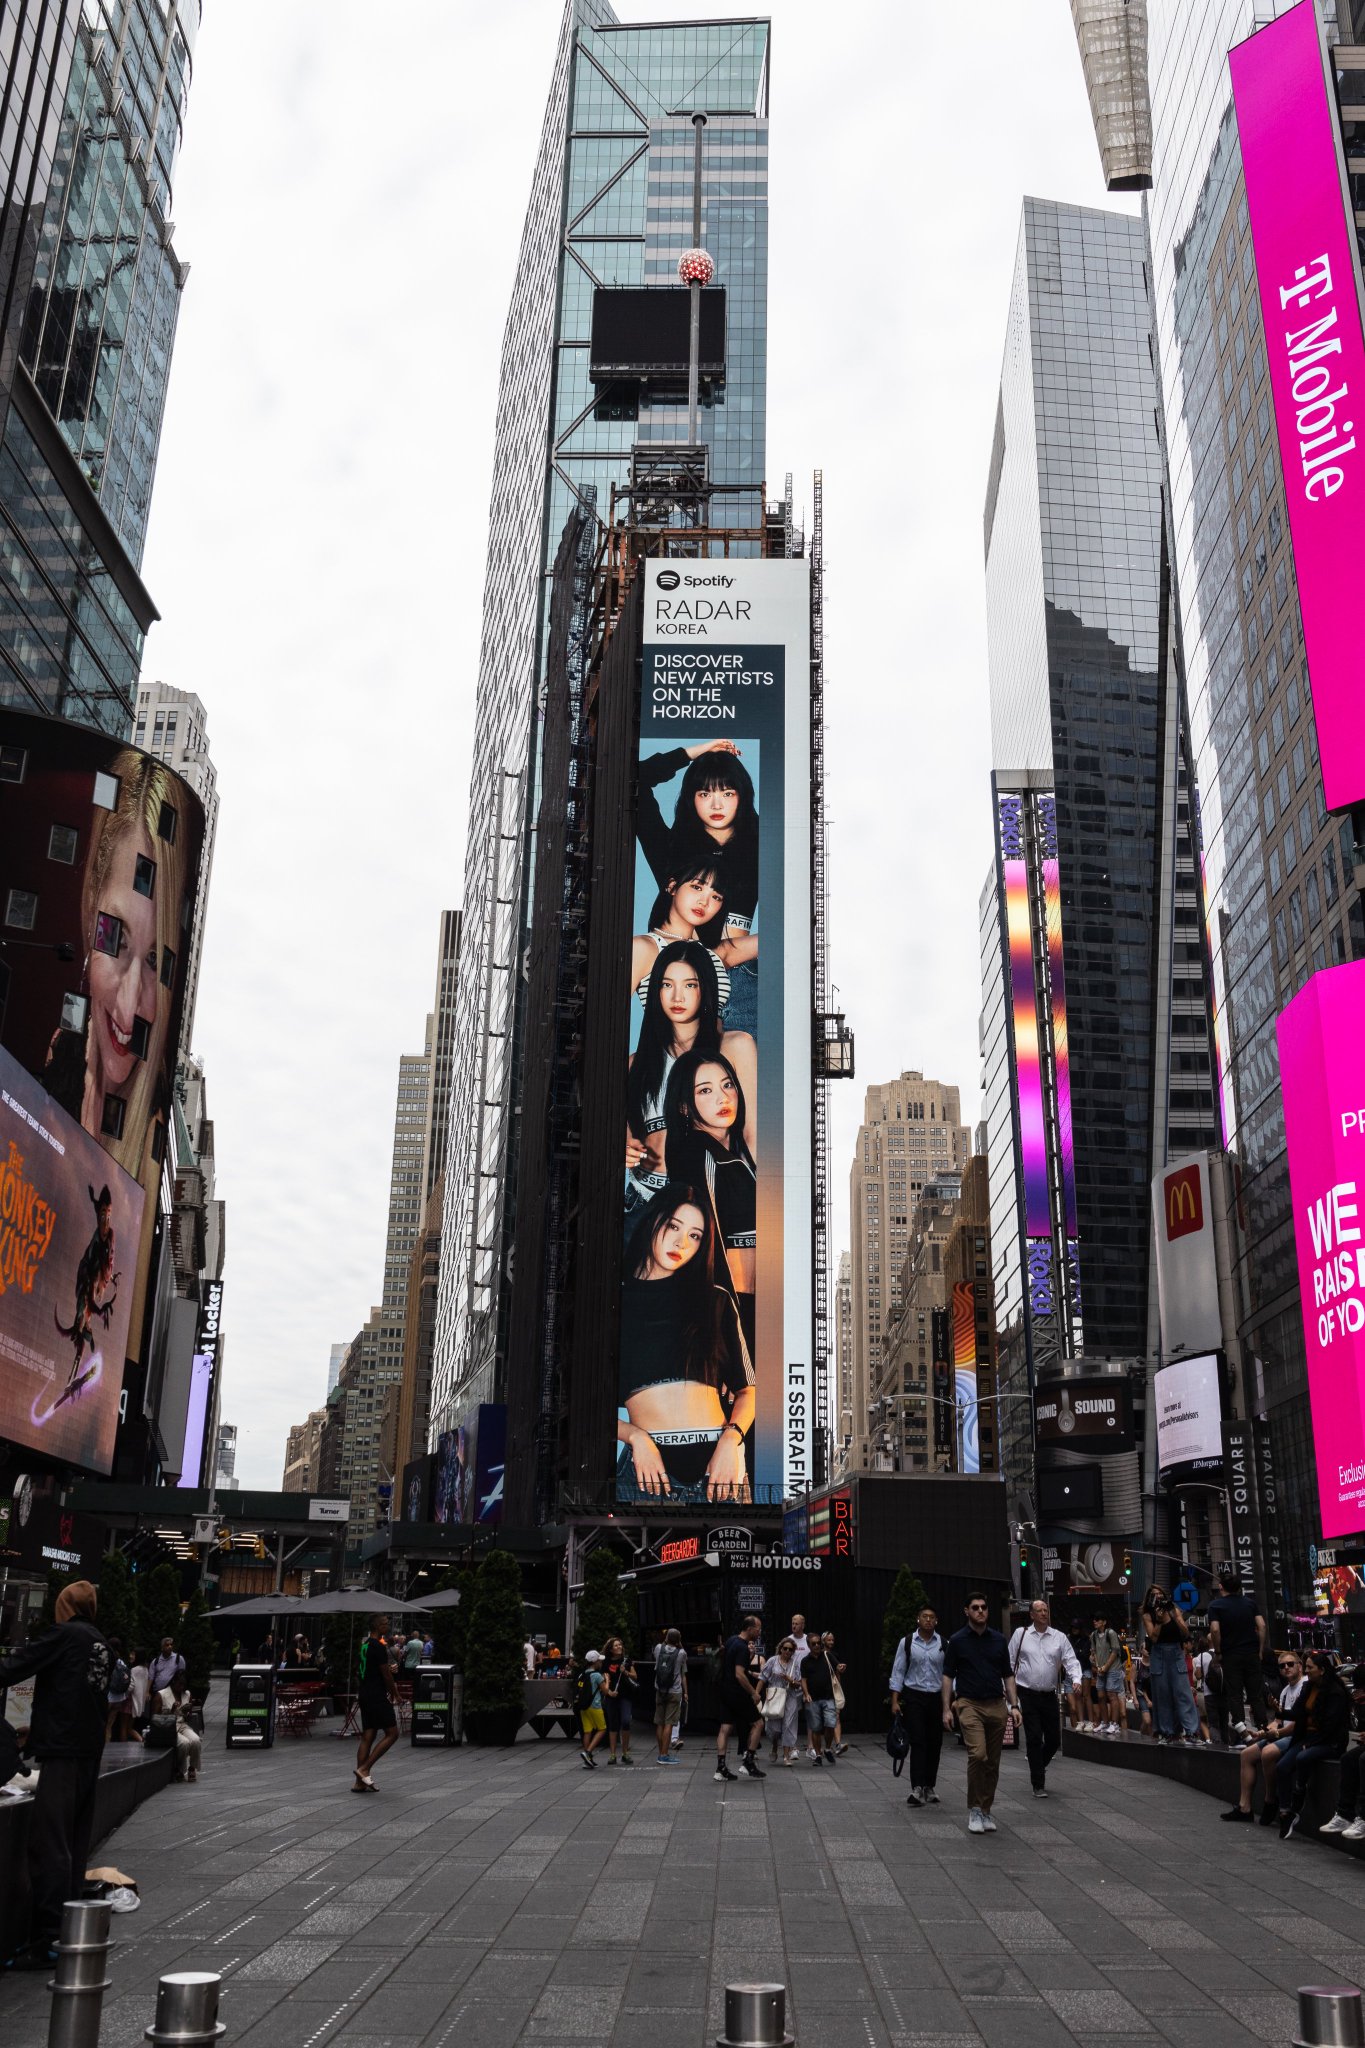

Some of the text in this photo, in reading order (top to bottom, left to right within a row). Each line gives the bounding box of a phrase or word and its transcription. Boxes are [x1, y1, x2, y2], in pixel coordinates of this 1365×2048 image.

[684, 575, 734, 588] Spotify
[656, 600, 752, 620] RADAR
[656, 623, 708, 635] KOREA
[654, 654, 744, 668] DISCOVER
[653, 671, 774, 685] NEW ARTISTS
[652, 688, 721, 702] ON THE
[652, 705, 736, 719] HORIZON
[1307, 1182, 1361, 1259] WE
[1318, 1308, 1336, 1348] OF
[788, 1363, 805, 1386] LE
[1075, 1398, 1116, 1415] SOUND
[1230, 1435, 1255, 1596] TIMES SQUARE
[718, 1529, 740, 1539] BEER
[835, 1501, 849, 1556] BAR
[711, 1540, 747, 1550] GARDEN
[730, 1561, 749, 1569] best
[752, 1555, 822, 1570] HOTDOGS
[1044, 1570, 1054, 1582] PRO
